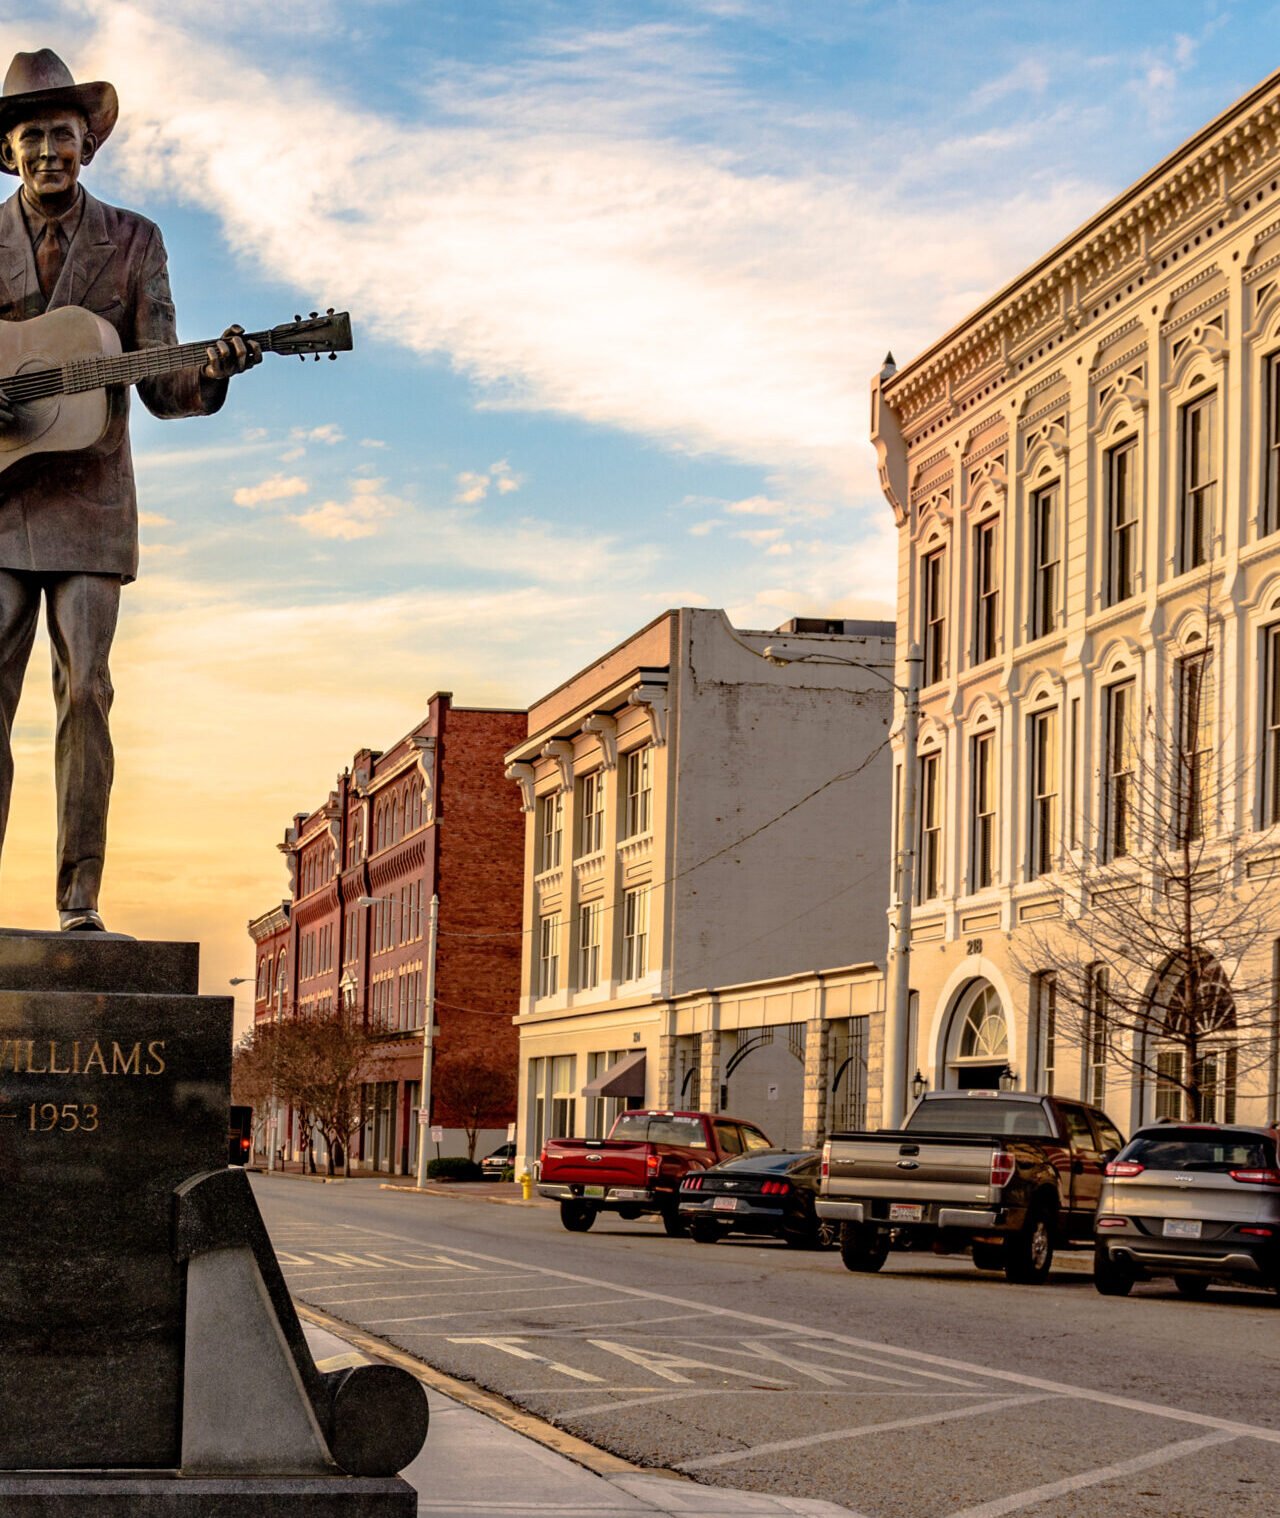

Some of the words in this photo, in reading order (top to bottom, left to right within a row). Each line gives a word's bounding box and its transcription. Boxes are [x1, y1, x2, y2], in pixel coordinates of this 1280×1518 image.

[966, 938, 982, 955] 218
[28, 1102, 99, 1132] 1953
[445, 1337, 989, 1388] TAXI
